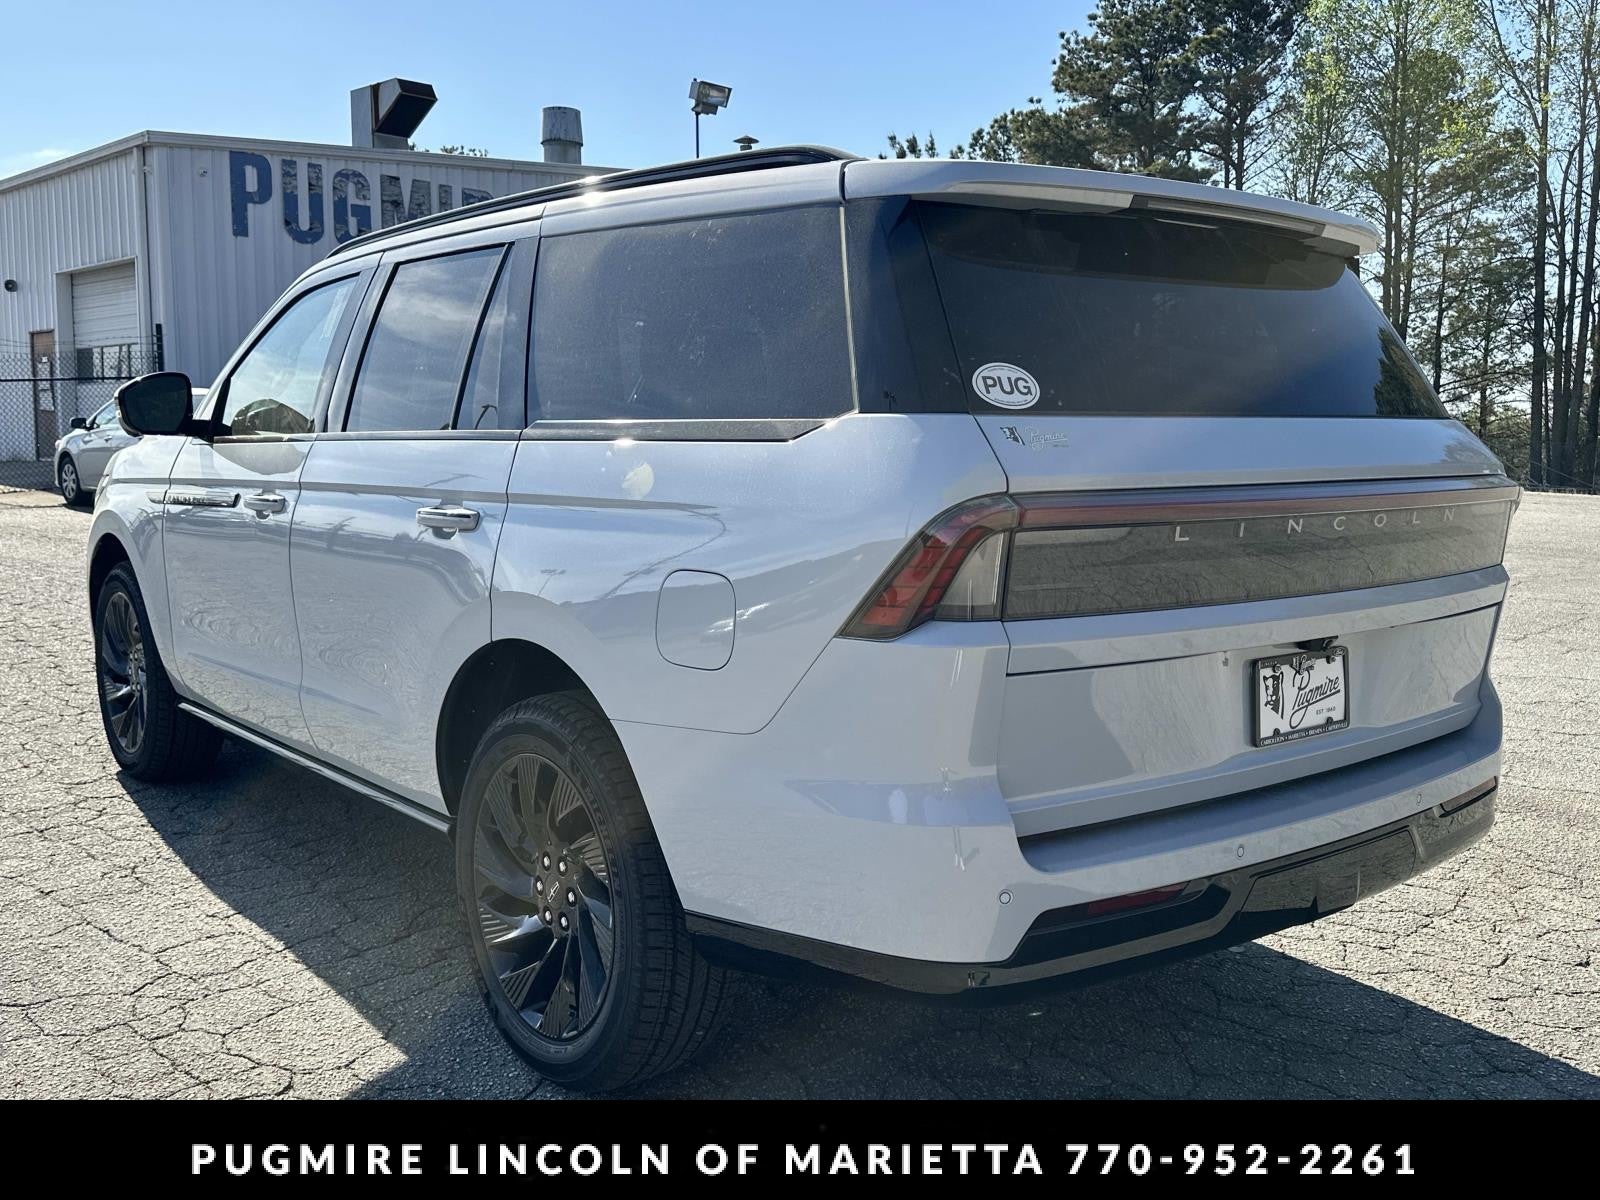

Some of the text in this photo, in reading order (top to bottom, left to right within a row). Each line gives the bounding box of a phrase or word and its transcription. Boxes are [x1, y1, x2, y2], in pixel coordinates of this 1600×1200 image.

[229, 151, 495, 245] PUGM
[981, 375, 1033, 396] PUG
[1174, 508, 1456, 543] LINCOLN
[1289, 668, 1341, 729] Pugmire
